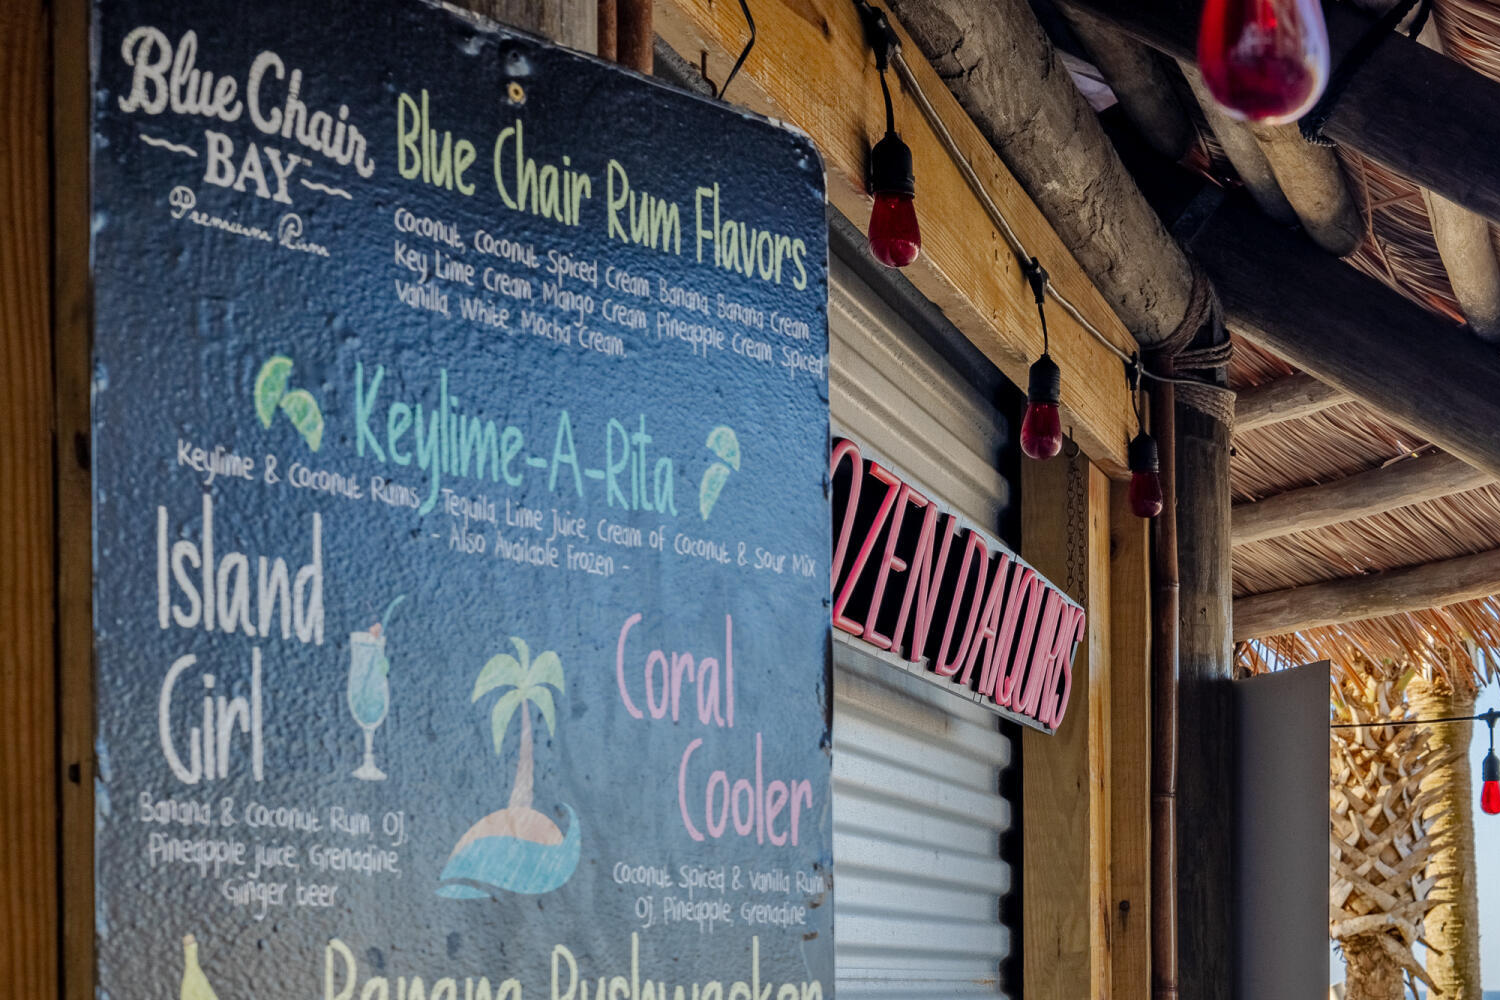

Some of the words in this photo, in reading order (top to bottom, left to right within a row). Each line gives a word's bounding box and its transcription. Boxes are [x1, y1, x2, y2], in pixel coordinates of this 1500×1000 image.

[118, 26, 243, 122] Blue
[247, 51, 375, 178] Chair
[398, 88, 477, 196] Blue
[494, 119, 592, 226] Chair
[608, 159, 681, 255] Rum
[696, 182, 807, 291] Flavors
[394, 208, 466, 254] Coconut,
[474, 229, 540, 268] Coconut
[547, 249, 598, 289] Spiced
[717, 293, 764, 331] Banana
[394, 240, 427, 284] Key
[435, 249, 475, 286] Lime
[543, 280, 594, 328] Mango
[657, 311, 725, 358] Pineapple
[521, 309, 571, 346] Mocha
[355, 361, 678, 516] Keylime-A-Rita
[157, 493, 325, 646] Island
[264, 454, 281, 484] &
[288, 462, 364, 500] Coconut
[505, 497, 543, 531] Lime
[546, 508, 590, 544] Juice,
[597, 518, 642, 548] Cream
[649, 525, 666, 551] of
[674, 531, 731, 565] Coconut
[736, 541, 748, 566] &
[754, 547, 787, 575] Sour
[792, 553, 816, 578] Mix
[450, 522, 486, 554] Also
[495, 530, 560, 568] Available
[566, 544, 614, 576] Frozen
[158, 646, 264, 785] Girl
[616, 612, 734, 728] Coral
[139, 791, 211, 826] Banana
[220, 797, 238, 828] &
[245, 802, 323, 832] Coconut
[678, 731, 813, 847] Cooler
[149, 832, 246, 879] Pineapple
[222, 875, 287, 921] Ginger
[612, 861, 674, 889] Coconut
[678, 864, 725, 899] Spiced
[731, 865, 744, 891] &
[749, 868, 790, 894] Vanilla
[740, 901, 806, 928] Grenadine
